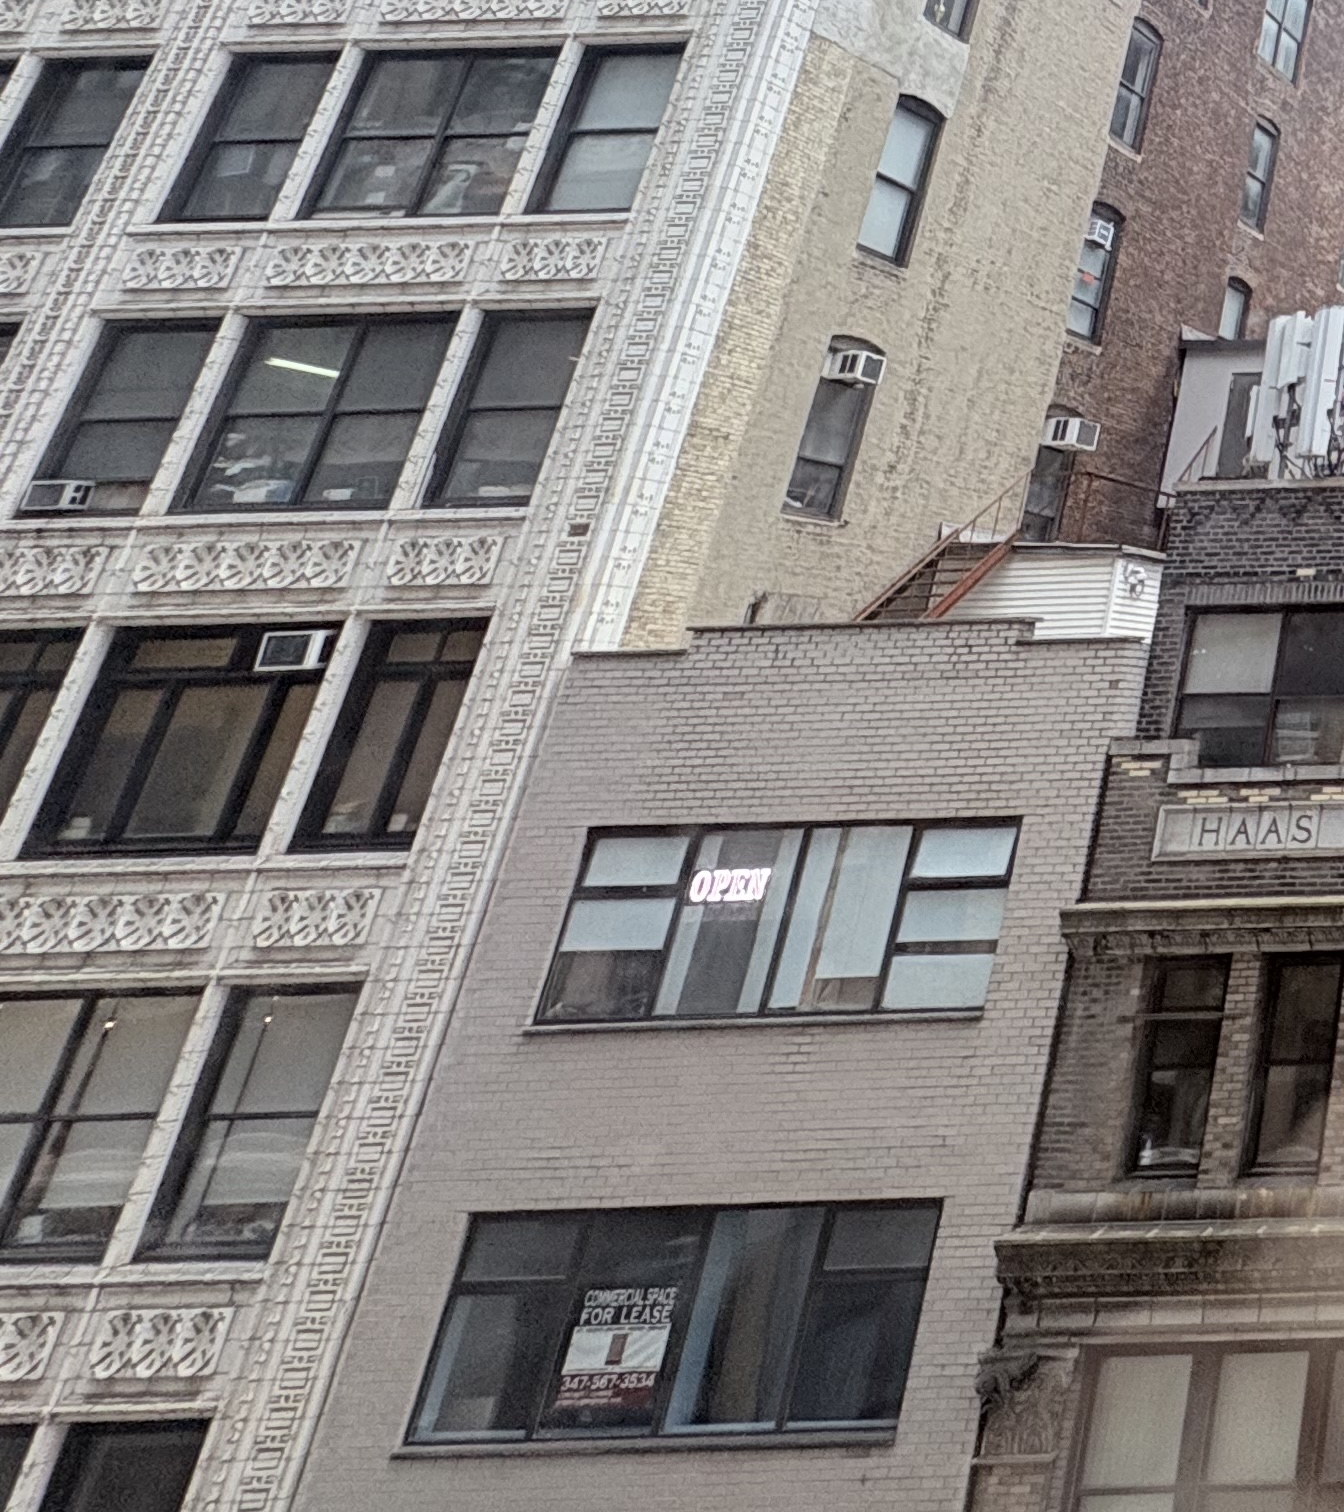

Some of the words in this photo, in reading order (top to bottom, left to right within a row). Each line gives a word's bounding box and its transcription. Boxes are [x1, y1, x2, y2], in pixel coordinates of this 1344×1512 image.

[1197, 814, 1314, 847] HAAS
[689, 868, 771, 902] OPEN
[584, 1288, 645, 1307] COMMERCIAL
[645, 1287, 678, 1305] SPACE
[580, 1307, 615, 1325] FOR
[620, 1306, 673, 1324] LEASE
